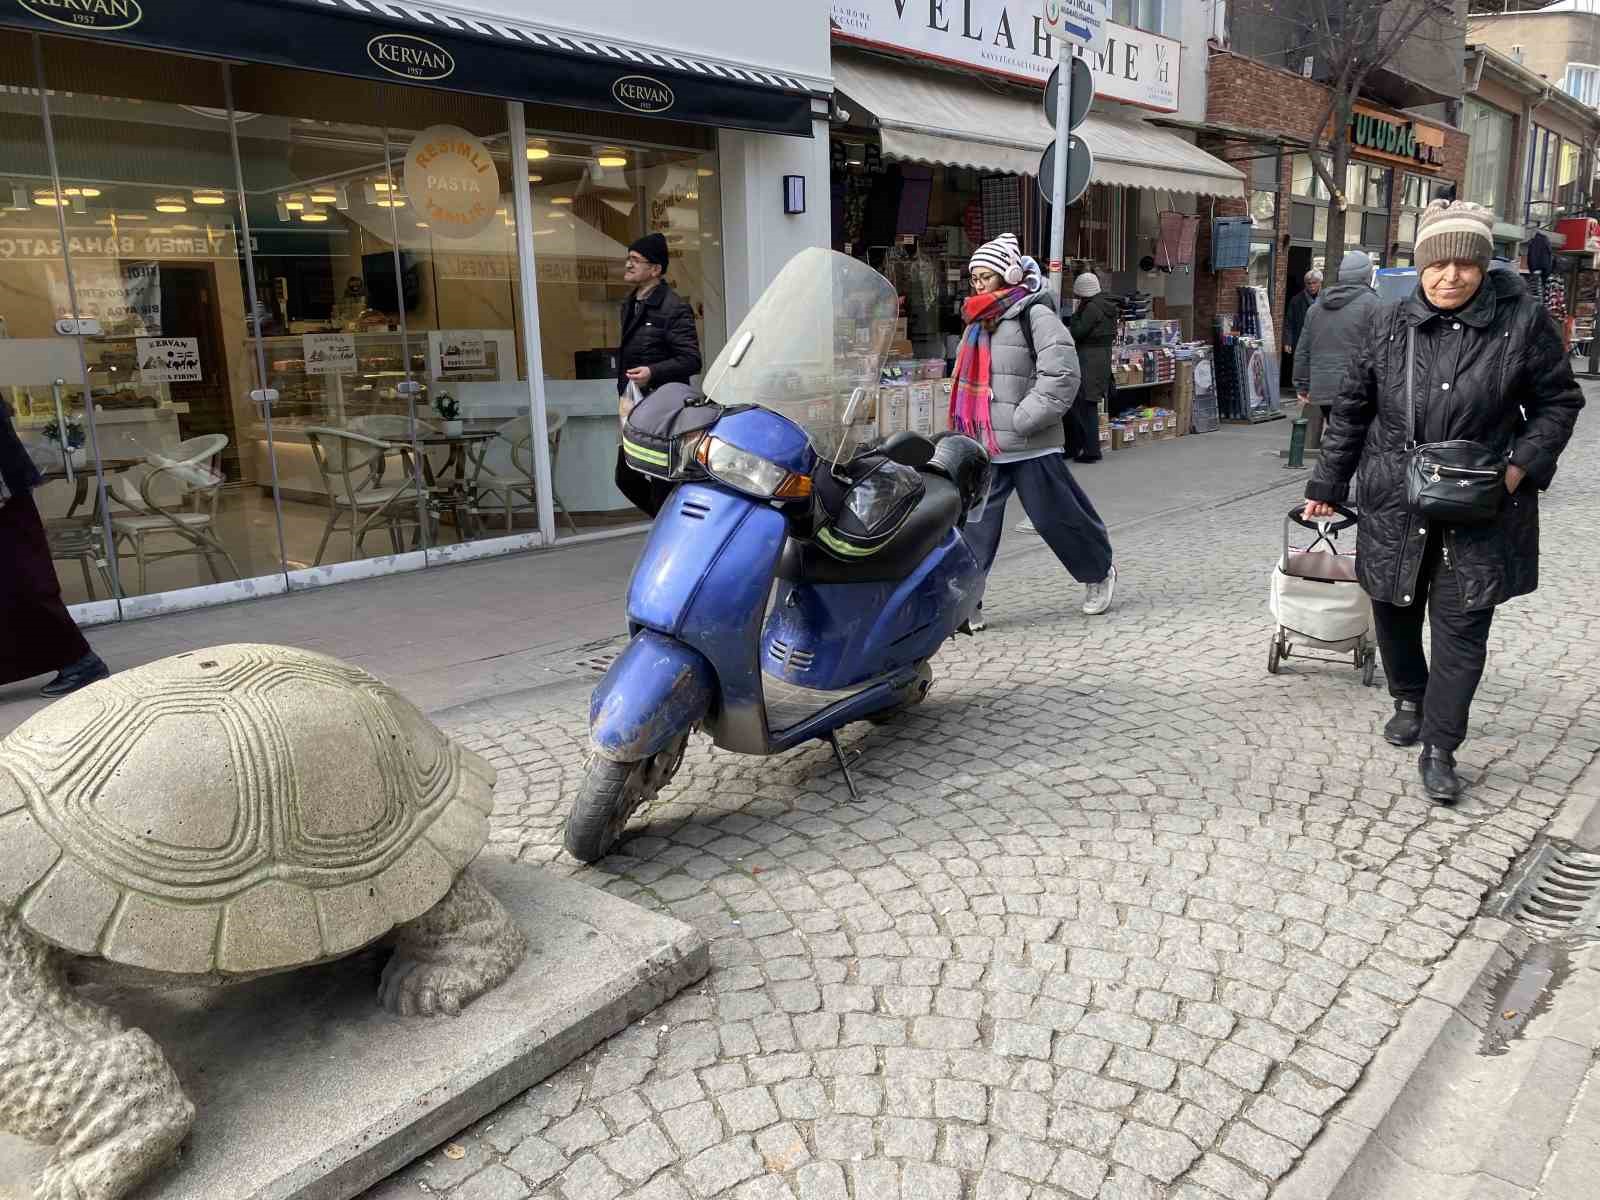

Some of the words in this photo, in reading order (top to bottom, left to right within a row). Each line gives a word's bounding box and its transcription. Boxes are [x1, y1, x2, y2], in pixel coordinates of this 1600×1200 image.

[30, 0, 128, 17] VAN
[378, 42, 446, 69] KERVAN
[1032, 16, 1139, 82] HME
[620, 83, 668, 104] KERVAN
[427, 175, 480, 192] PASTA
